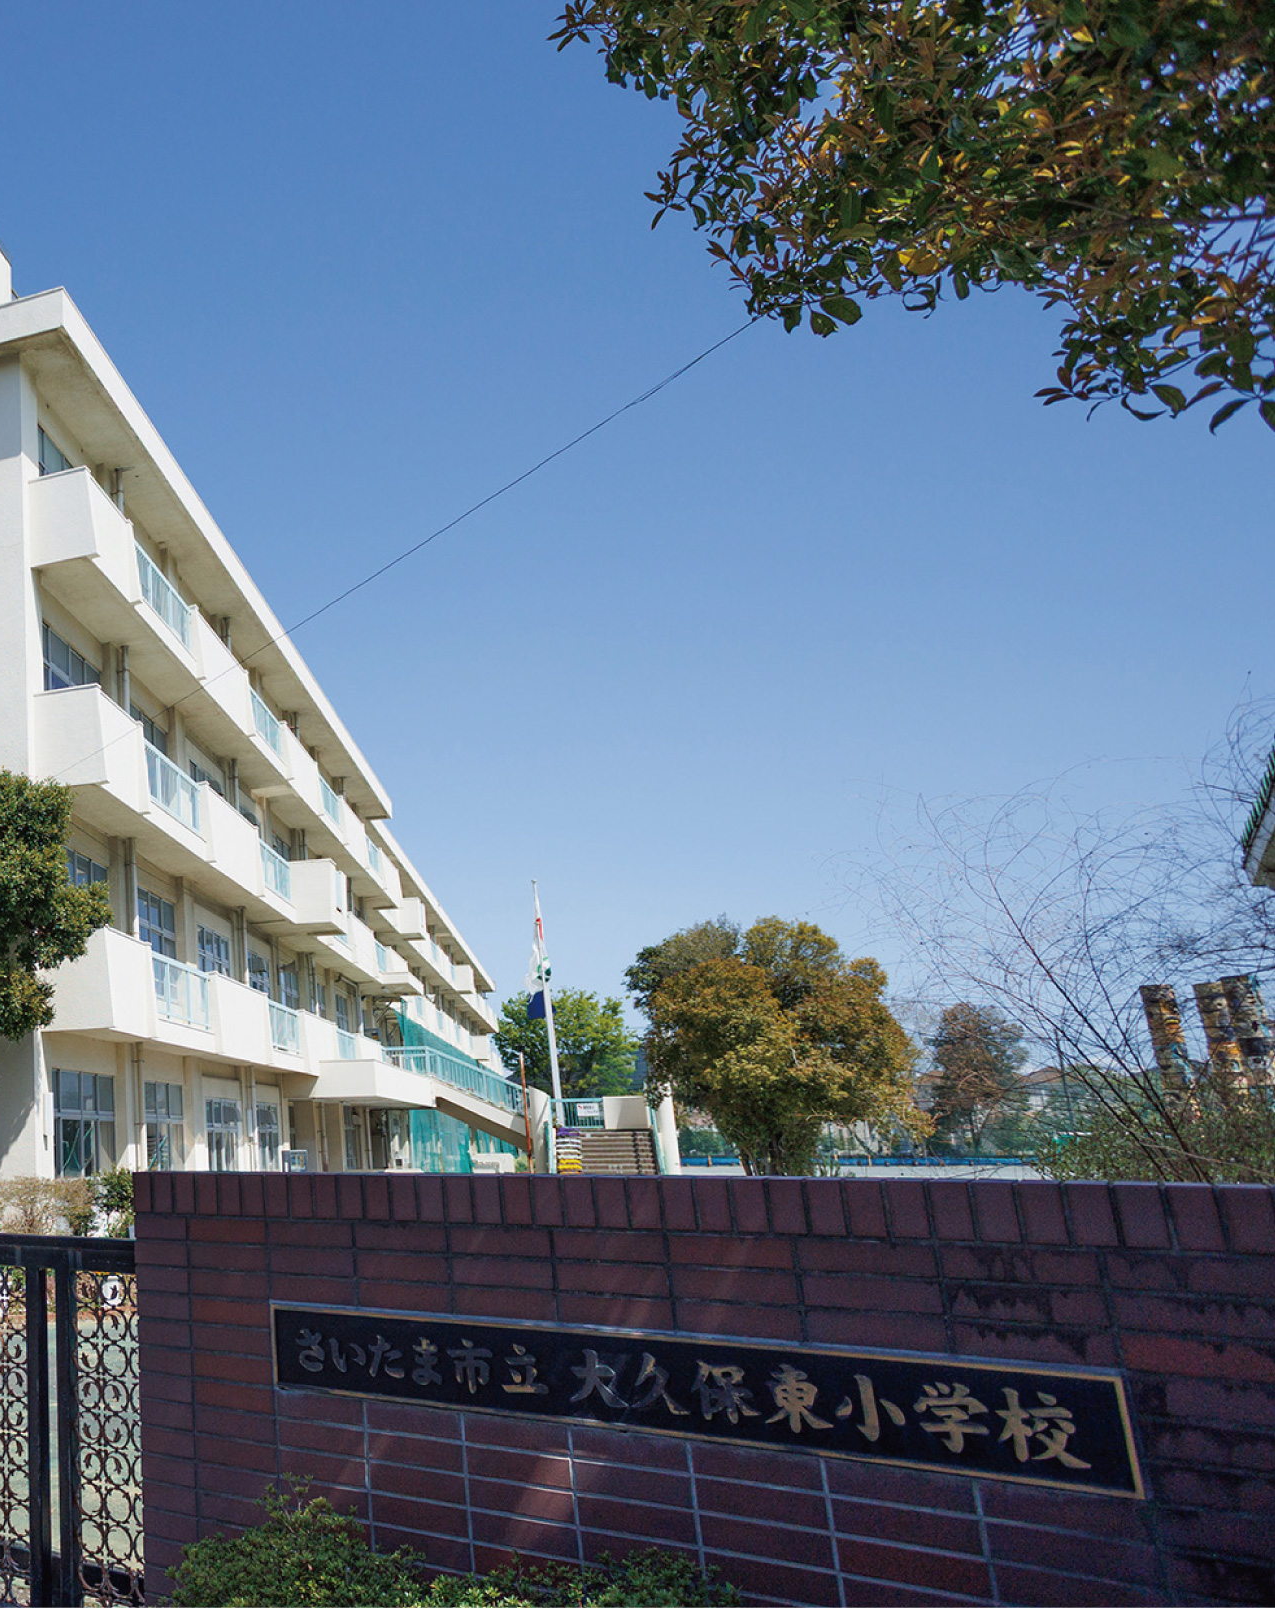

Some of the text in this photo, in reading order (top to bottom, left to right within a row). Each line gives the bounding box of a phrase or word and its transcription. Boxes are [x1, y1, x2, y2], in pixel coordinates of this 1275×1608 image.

[295, 1328, 1092, 1470] さいたま市立 大久保東小学校
